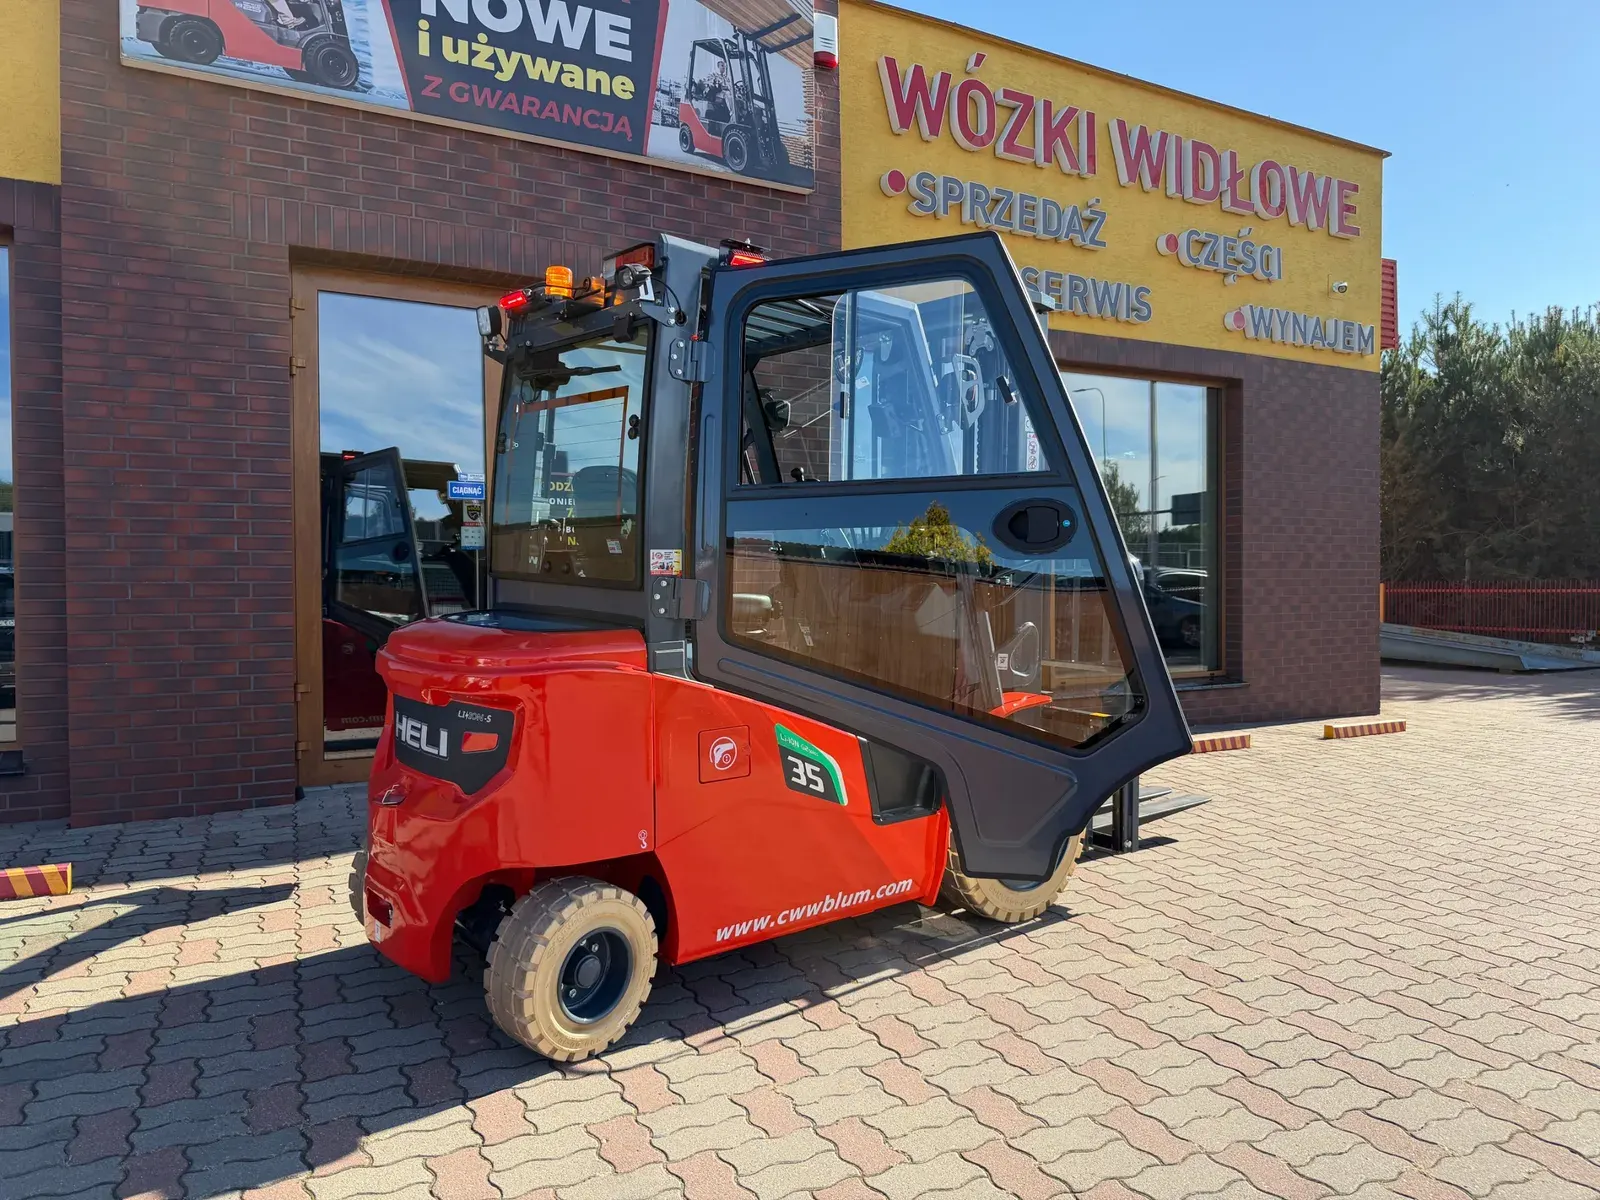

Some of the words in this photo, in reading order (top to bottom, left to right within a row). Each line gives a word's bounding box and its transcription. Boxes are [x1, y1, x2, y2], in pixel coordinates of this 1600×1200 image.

[417, 19, 430, 57] i
[441, 32, 635, 100] używane
[421, 74, 443, 99] Z
[449, 81, 633, 142] GWARANCJĄ
[877, 52, 1097, 179] WÓZKI
[1109, 118, 1361, 239] WIDŁOWE
[907, 171, 1107, 249] SPRZEDAŻ
[1178, 228, 1282, 286] CZĘŚCI
[1020, 266, 1152, 325] SERWIS
[1241, 304, 1375, 356] WYNAJEM
[452, 485, 482, 496] CIĄGNĄĆ
[394, 711, 448, 758] HELI
[787, 755, 825, 793] 35
[715, 878, 913, 942] www.cwwblum.com
